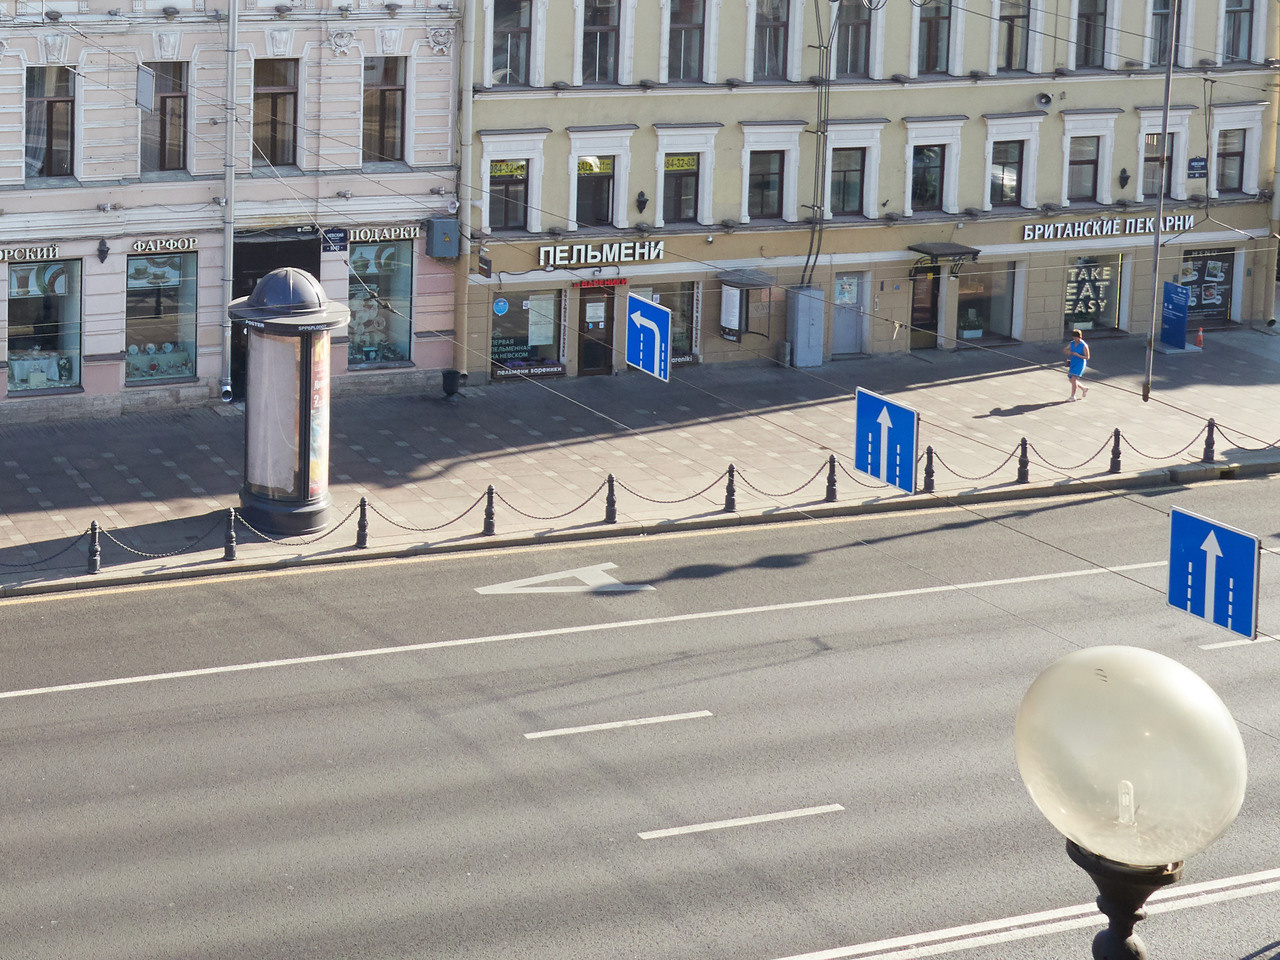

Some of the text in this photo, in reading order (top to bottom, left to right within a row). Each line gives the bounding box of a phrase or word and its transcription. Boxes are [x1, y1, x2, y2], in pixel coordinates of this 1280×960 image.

[350, 226, 420, 243] ПОДАРКИ
[1023, 219, 1121, 240] БРИТАНСКИЕ
[133, 237, 199, 252] ФАРФОР
[539, 241, 665, 266] ПЕЛЬМЕНИ
[1068, 267, 1112, 281] TAKE
[1065, 281, 1110, 299] EAT
[1064, 299, 1108, 314] EASY
